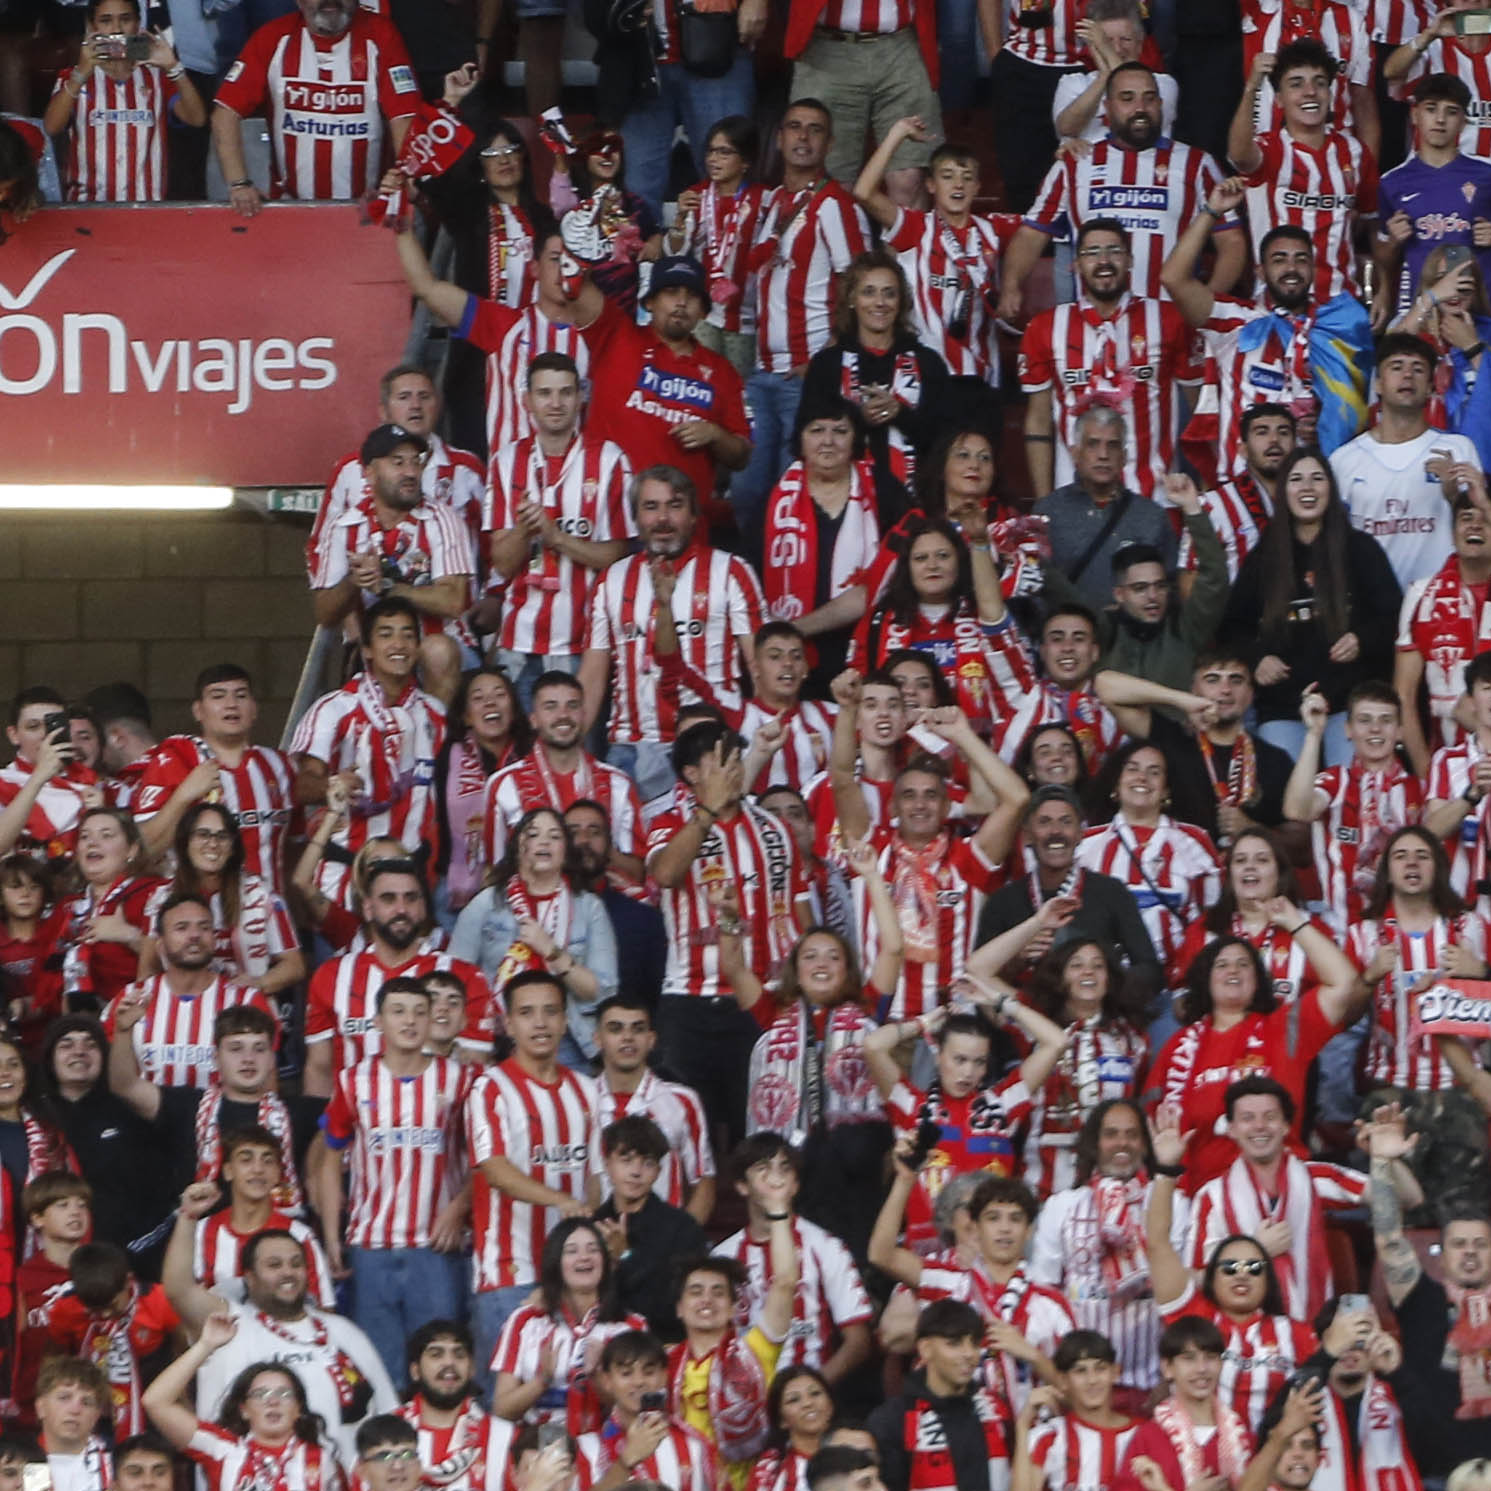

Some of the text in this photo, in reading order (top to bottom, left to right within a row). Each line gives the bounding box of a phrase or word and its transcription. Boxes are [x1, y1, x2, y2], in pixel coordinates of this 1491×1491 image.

[283, 113, 368, 138] Asturias
[131, 337, 337, 414] viajes
[1386, 498, 1410, 517] Fly
[1364, 516, 1435, 538] Emirates
